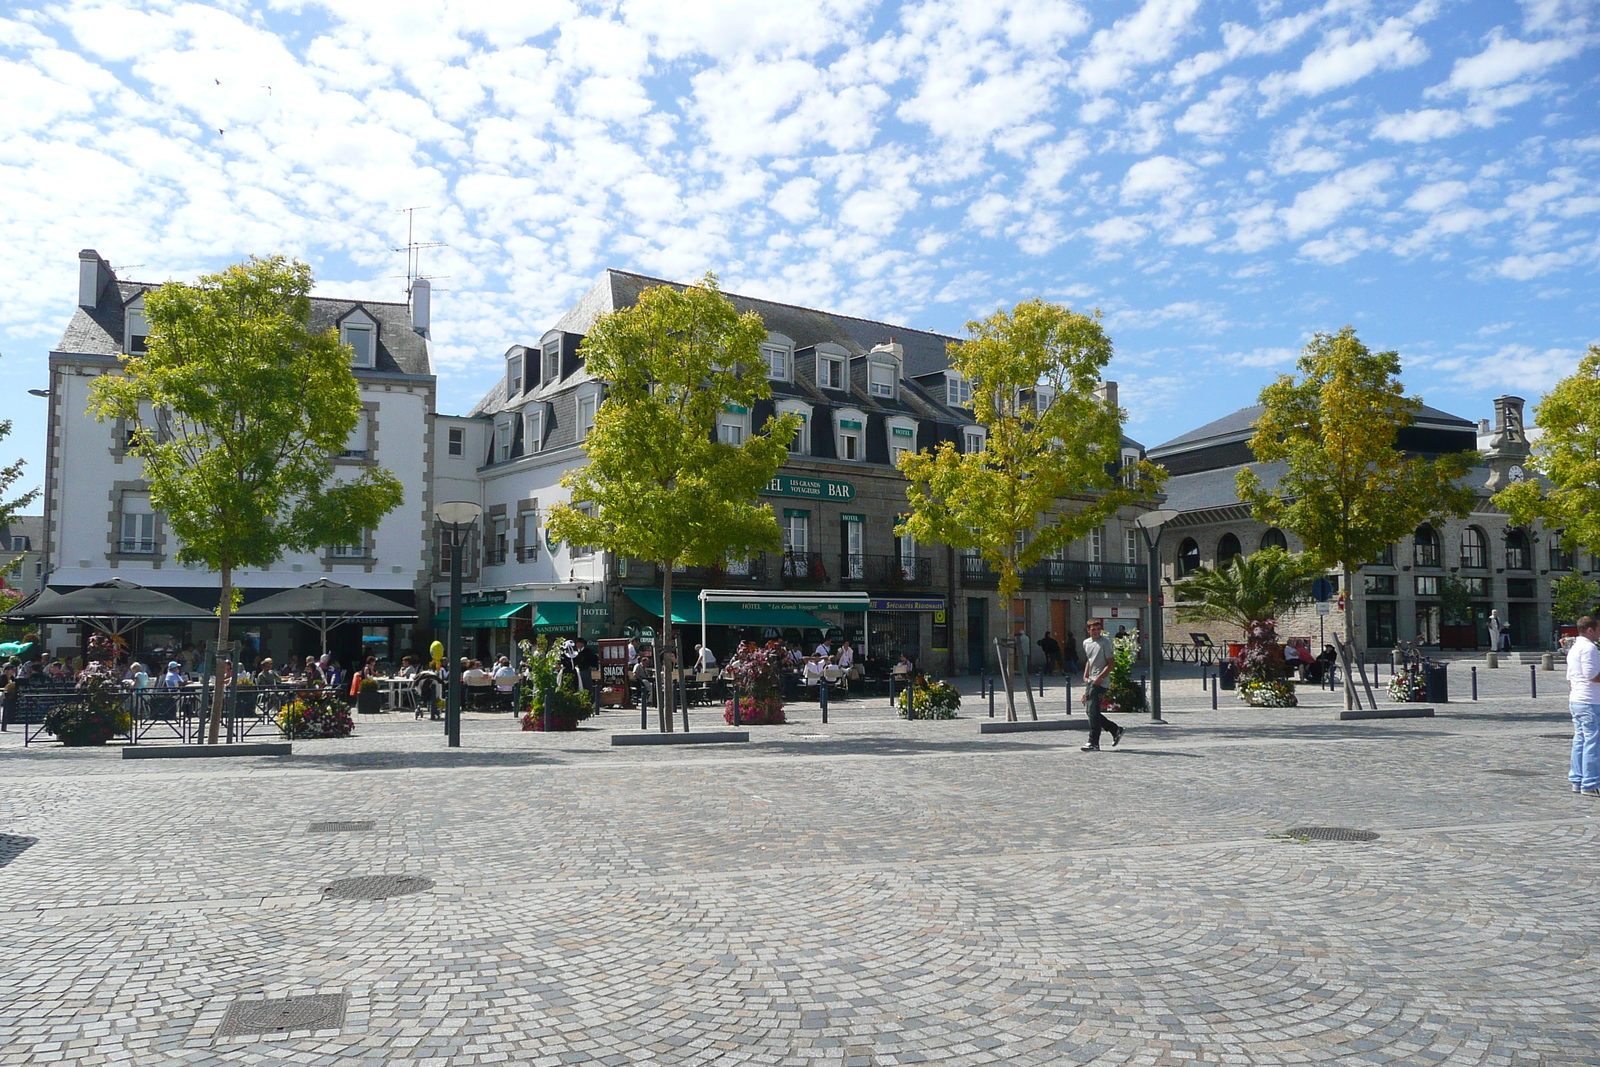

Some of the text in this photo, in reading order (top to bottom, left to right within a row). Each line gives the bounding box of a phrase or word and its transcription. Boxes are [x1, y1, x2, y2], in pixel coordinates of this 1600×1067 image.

[895, 428, 911, 436] HOTEL
[790, 486, 821, 495] VOYAGEURS
[828, 483, 850, 497] BAR
[582, 608, 609, 616] HOTEL
[603, 666, 624, 676] SNACK
